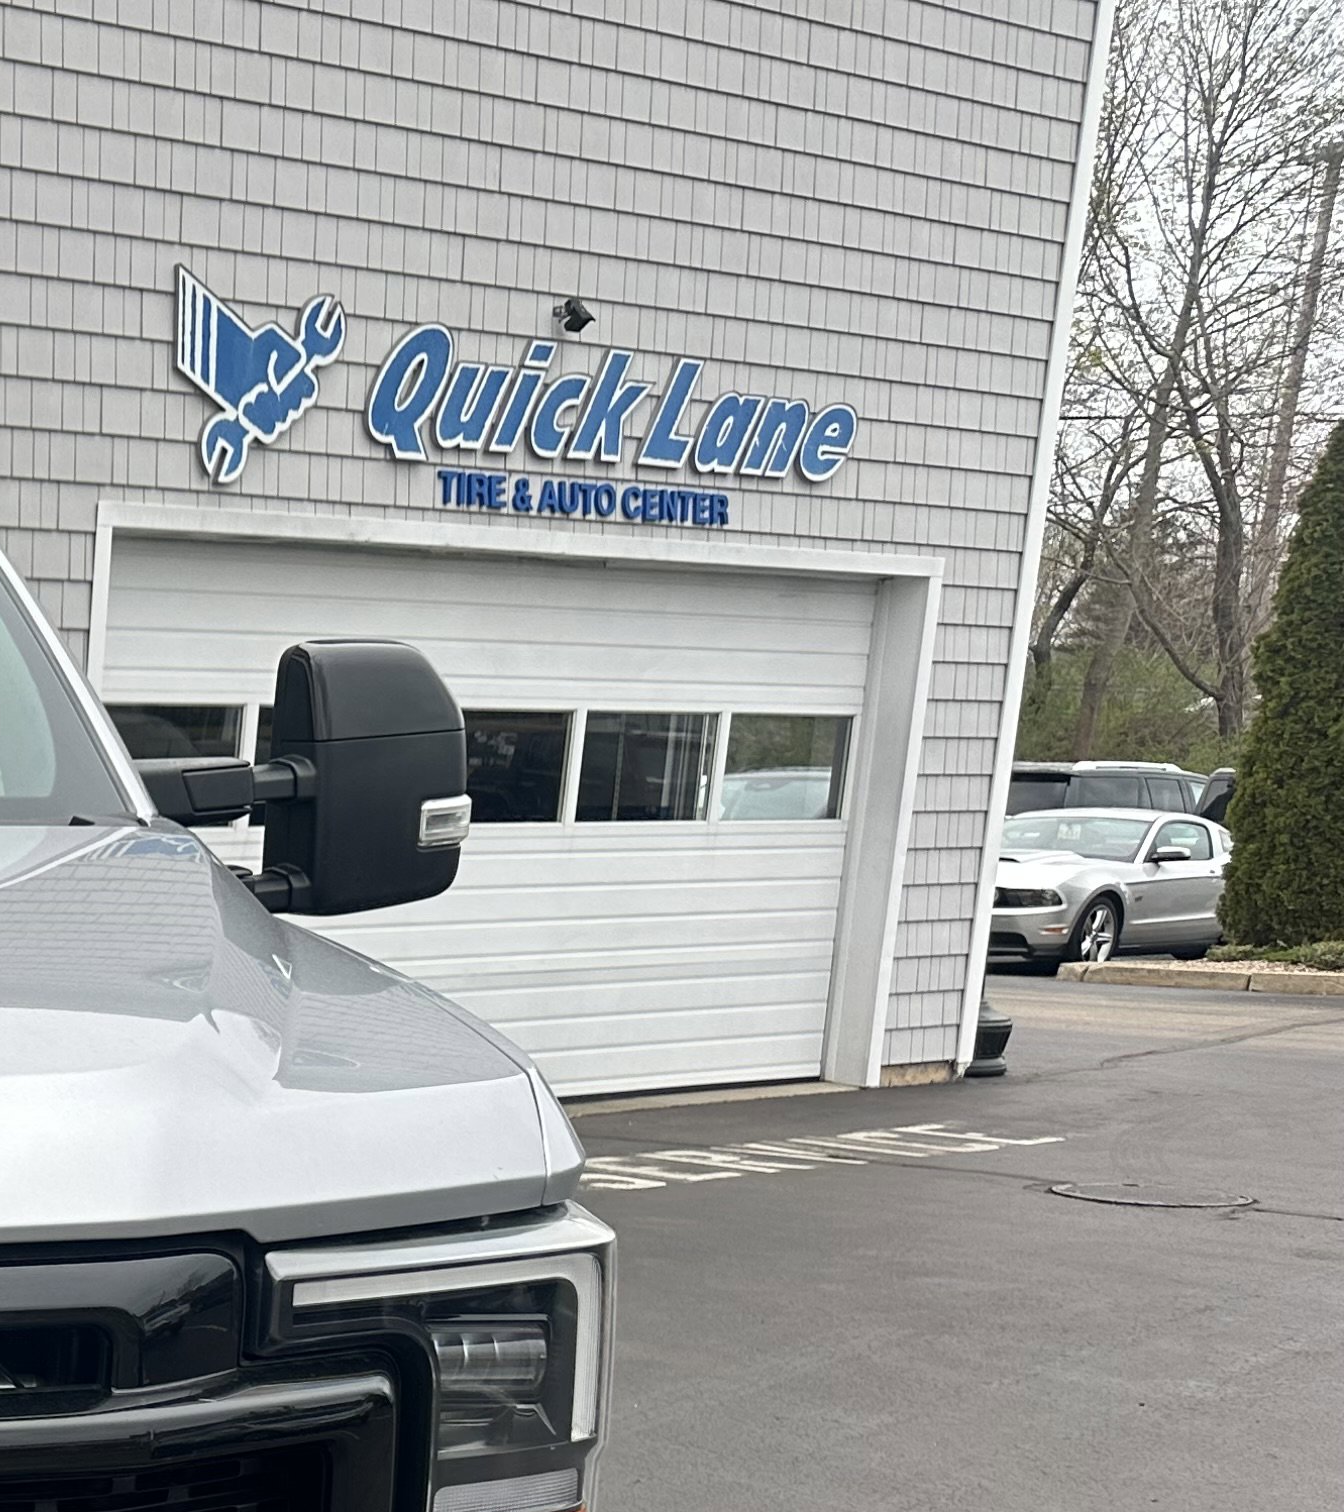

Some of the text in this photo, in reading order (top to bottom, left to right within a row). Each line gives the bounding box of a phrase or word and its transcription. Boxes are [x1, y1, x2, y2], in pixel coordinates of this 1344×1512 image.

[368, 322, 860, 484] Quick Lane
[437, 469, 730, 526] TIRE & AUTO CENTER
